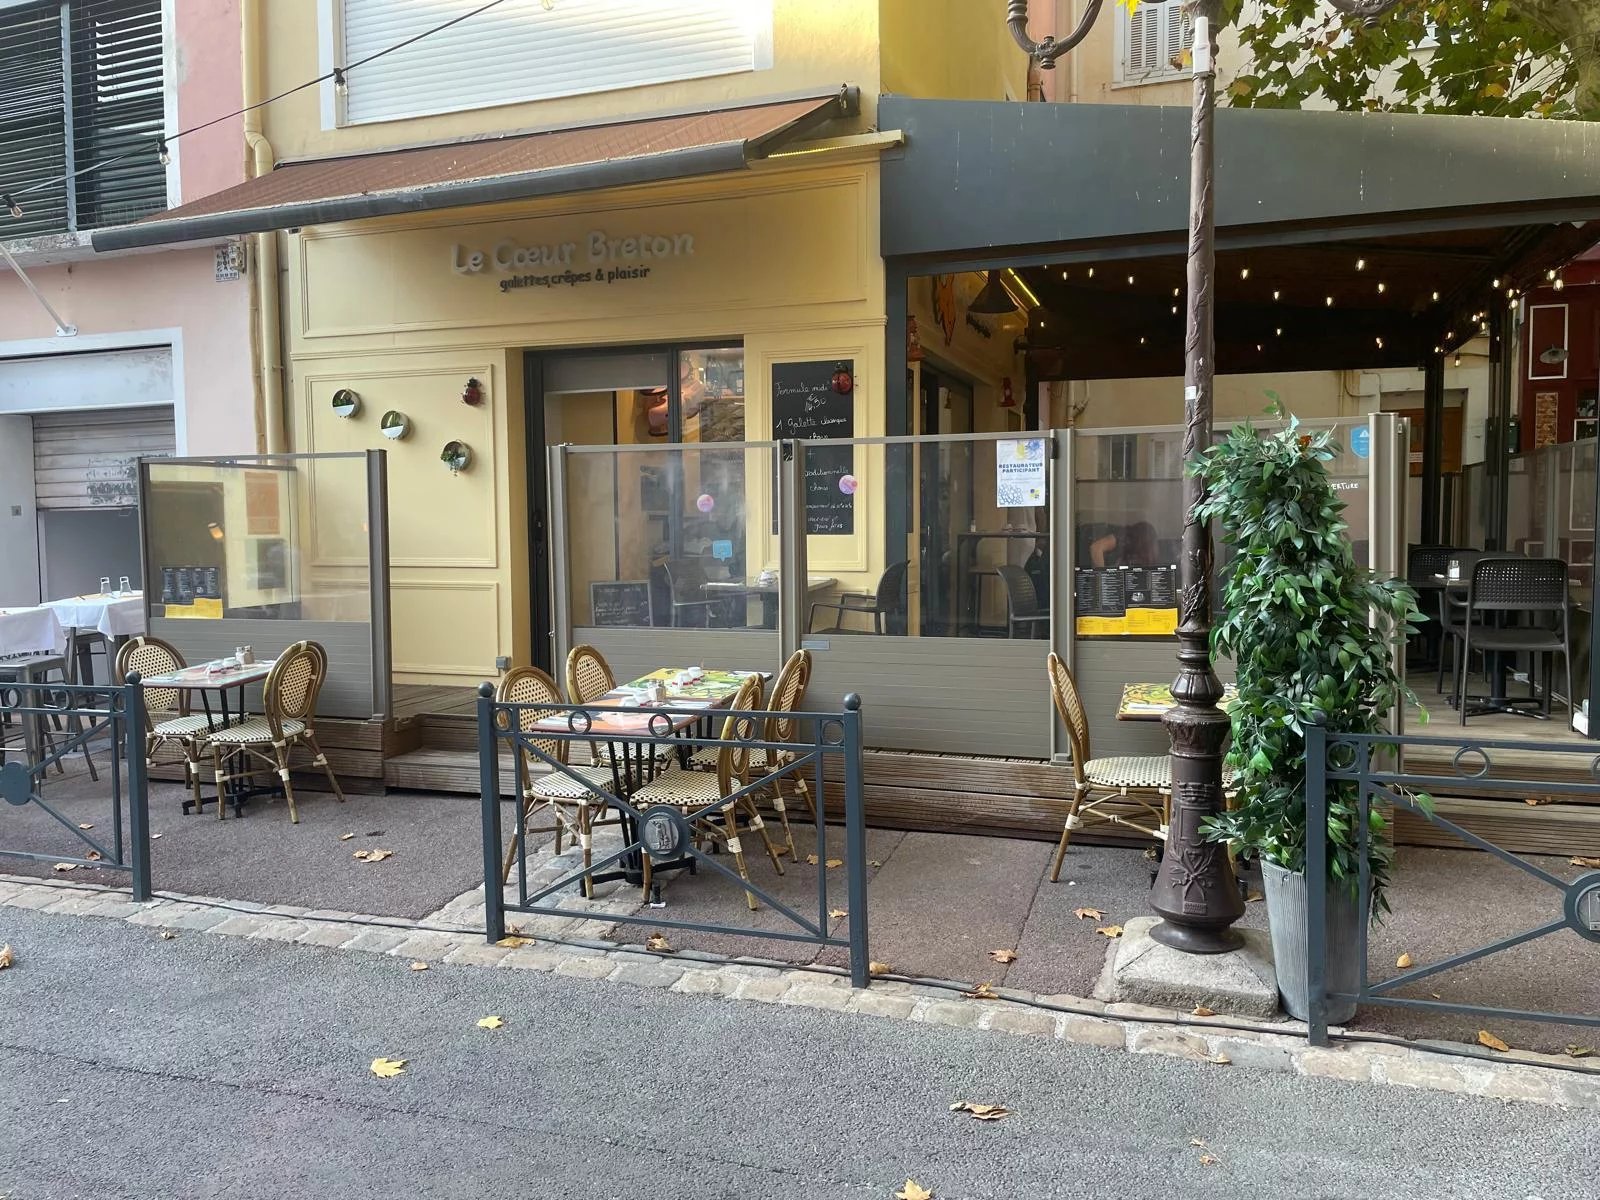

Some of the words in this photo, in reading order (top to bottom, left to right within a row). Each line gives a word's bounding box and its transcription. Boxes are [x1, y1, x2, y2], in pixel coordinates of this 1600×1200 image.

[450, 242, 484, 273] Le
[587, 228, 695, 264] Breton
[596, 267, 604, 281] &
[607, 264, 650, 284] plaisir
